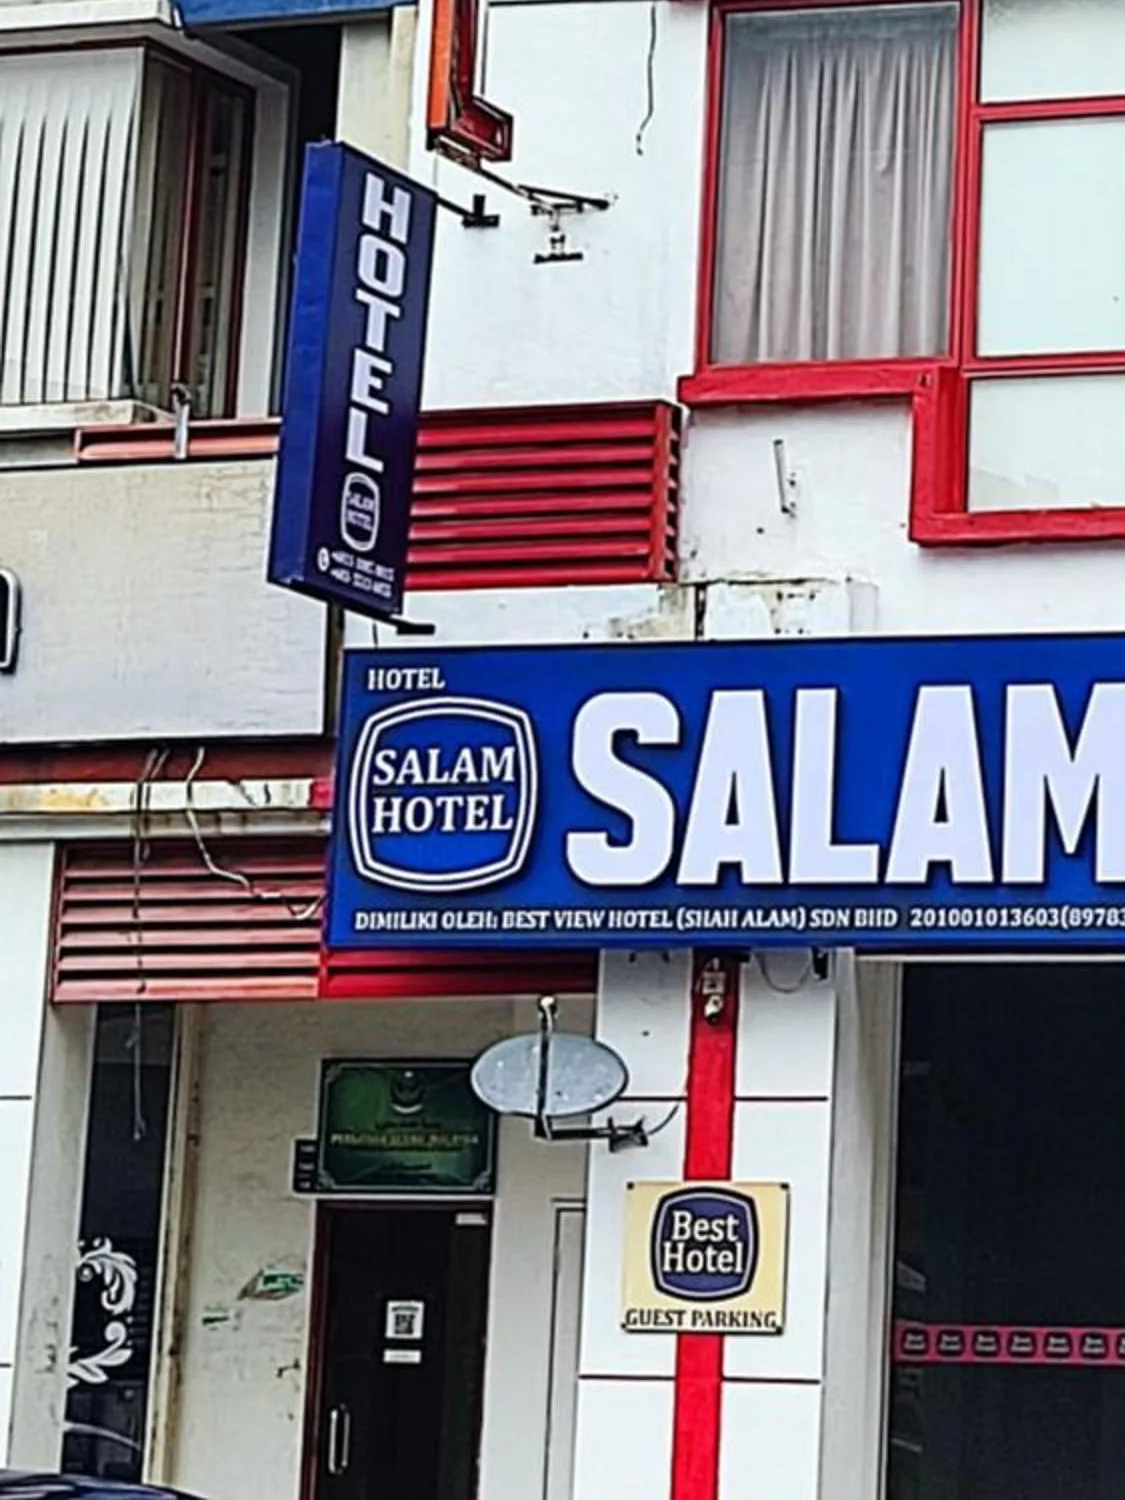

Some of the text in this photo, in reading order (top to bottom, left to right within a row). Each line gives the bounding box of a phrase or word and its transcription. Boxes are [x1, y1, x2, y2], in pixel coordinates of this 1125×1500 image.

[345, 172, 412, 474] HOTEL
[367, 667, 445, 691] HOTEL
[371, 745, 517, 788] SALAM
[370, 794, 515, 836] HOTEL
[355, 911, 437, 931] DIMILIKI
[441, 911, 498, 931] OLEH:
[502, 911, 550, 930] BEST
[553, 910, 605, 929] VIEW
[608, 910, 673, 930] HOTEL
[676, 908, 739, 931] (SHAH
[741, 908, 806, 931] ALAM)
[810, 908, 850, 928] SDN
[855, 908, 898, 928] BHD
[671, 1210, 740, 1243] Best
[663, 1241, 744, 1274] Hotel
[625, 1308, 778, 1329] GUEST PARKING
